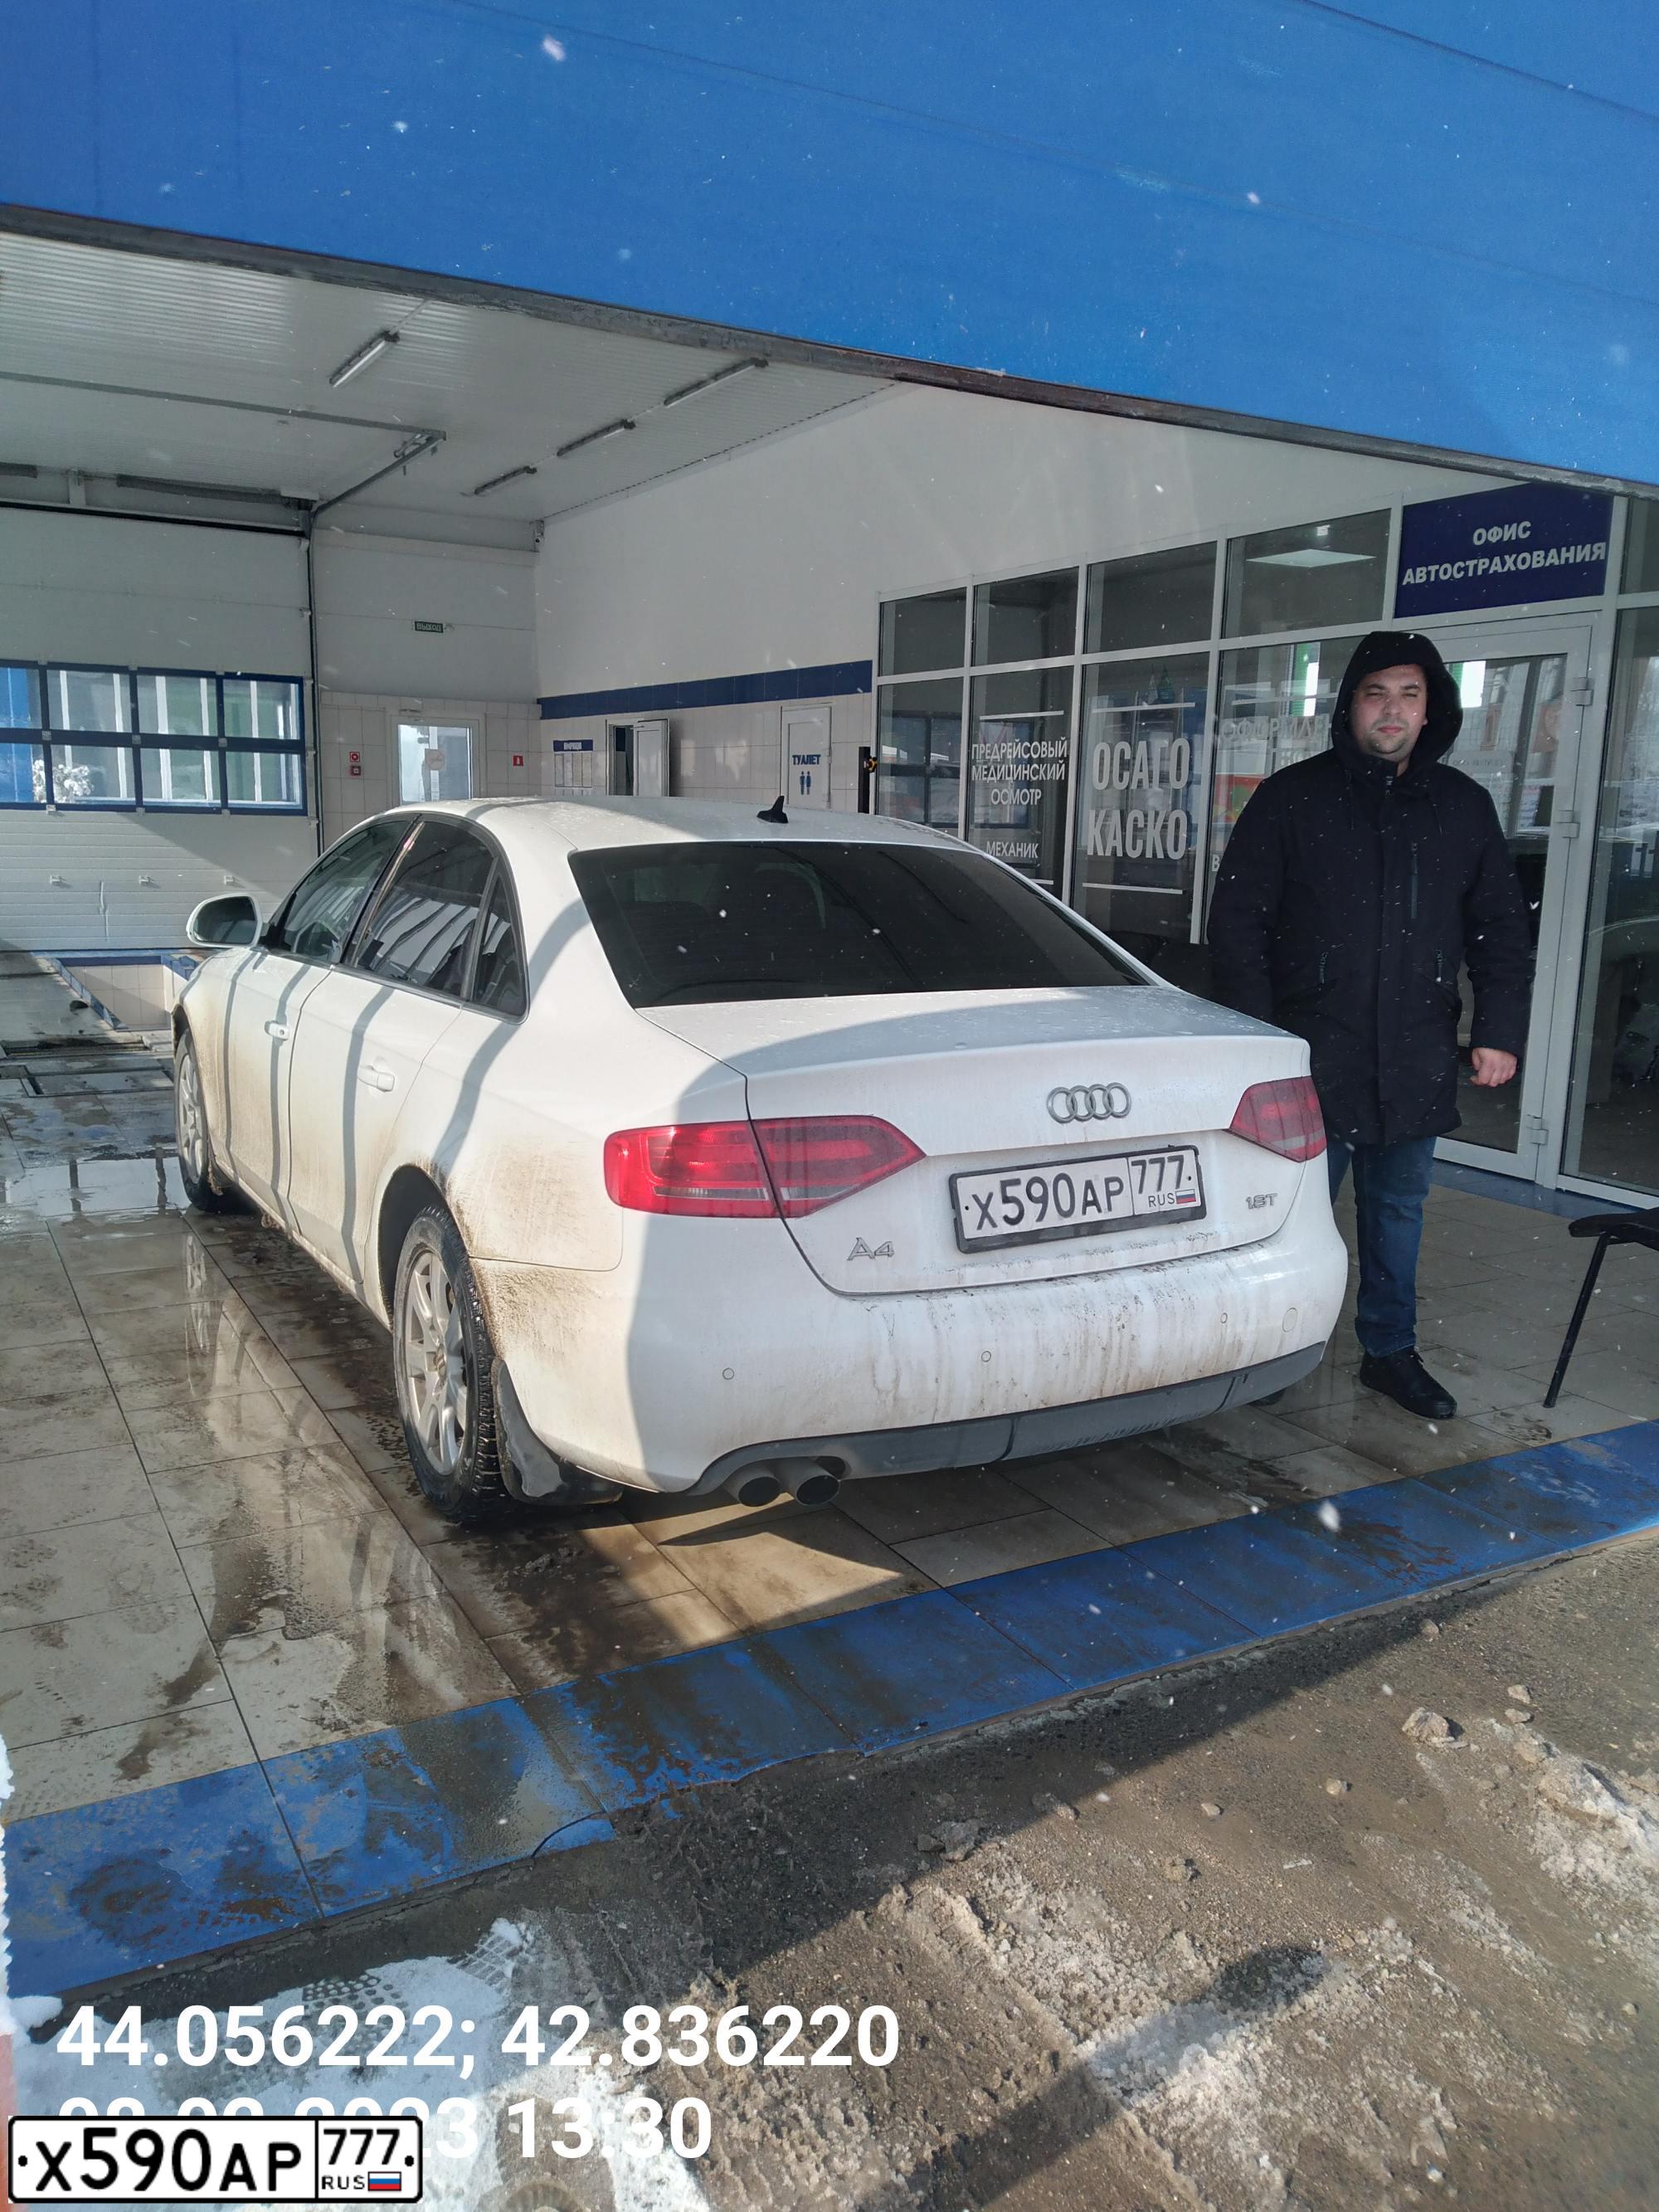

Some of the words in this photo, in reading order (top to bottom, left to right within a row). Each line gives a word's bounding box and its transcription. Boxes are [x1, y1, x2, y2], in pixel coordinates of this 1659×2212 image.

[1473, 521, 1531, 546] ОФИС
[1402, 542, 1607, 585] АВТОСТРАХОВАНИЯ
[792, 754, 821, 765] ТУАЛЕТ
[971, 736, 1068, 760] ПРЕДРЕЙСОВЫЙ
[971, 760, 1065, 784] МЕДИЦИНСКИЙ
[1092, 738, 1190, 791] ОСАГО
[990, 788, 1042, 806] ОСМОТР
[1087, 809, 1188, 860] КАСКО
[986, 840, 1039, 859] МЕХАНИК
[1131, 1154, 1185, 1195] 777
[1148, 1192, 1175, 1208] RUS
[846, 1236, 895, 1261] A4
